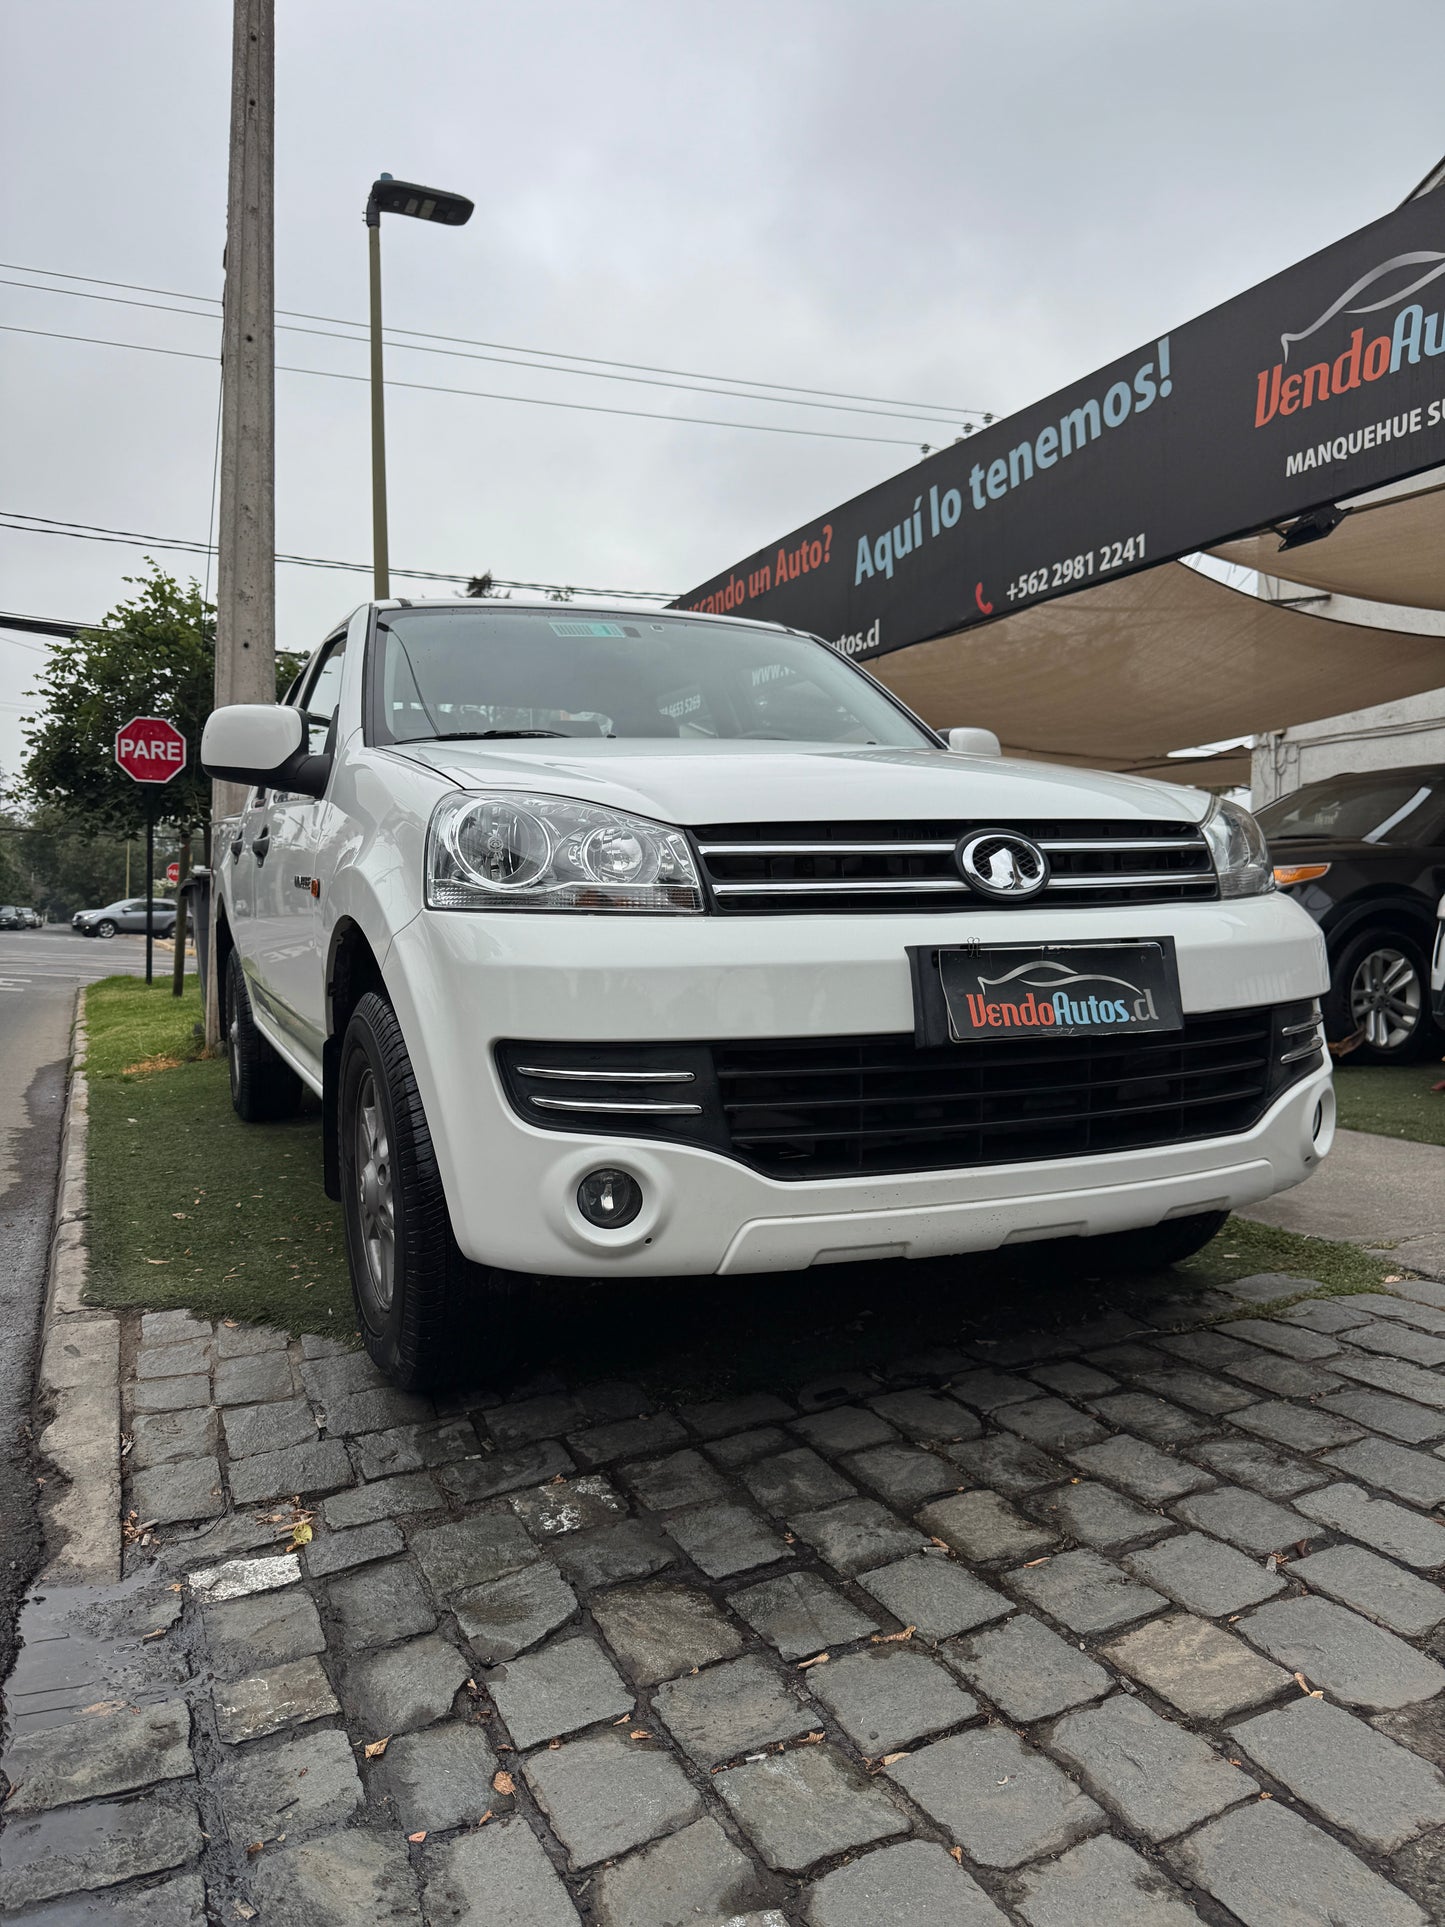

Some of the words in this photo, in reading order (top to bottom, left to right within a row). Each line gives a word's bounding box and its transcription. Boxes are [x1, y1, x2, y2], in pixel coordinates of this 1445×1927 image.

[855, 496, 922, 586] Aquí
[930, 485, 962, 538] lo
[969, 336, 1173, 510] tenemos!
[1286, 408, 1422, 477] MANQUEHUE
[675, 574, 745, 614] cando
[749, 565, 771, 598] un
[775, 524, 833, 587] Auto?
[1006, 567, 1049, 601] +562
[1051, 551, 1094, 588] 2981
[1100, 533, 1146, 571] 2241
[120, 738, 181, 762] PARE
[966, 988, 1160, 1028] VendoAutos.cl
